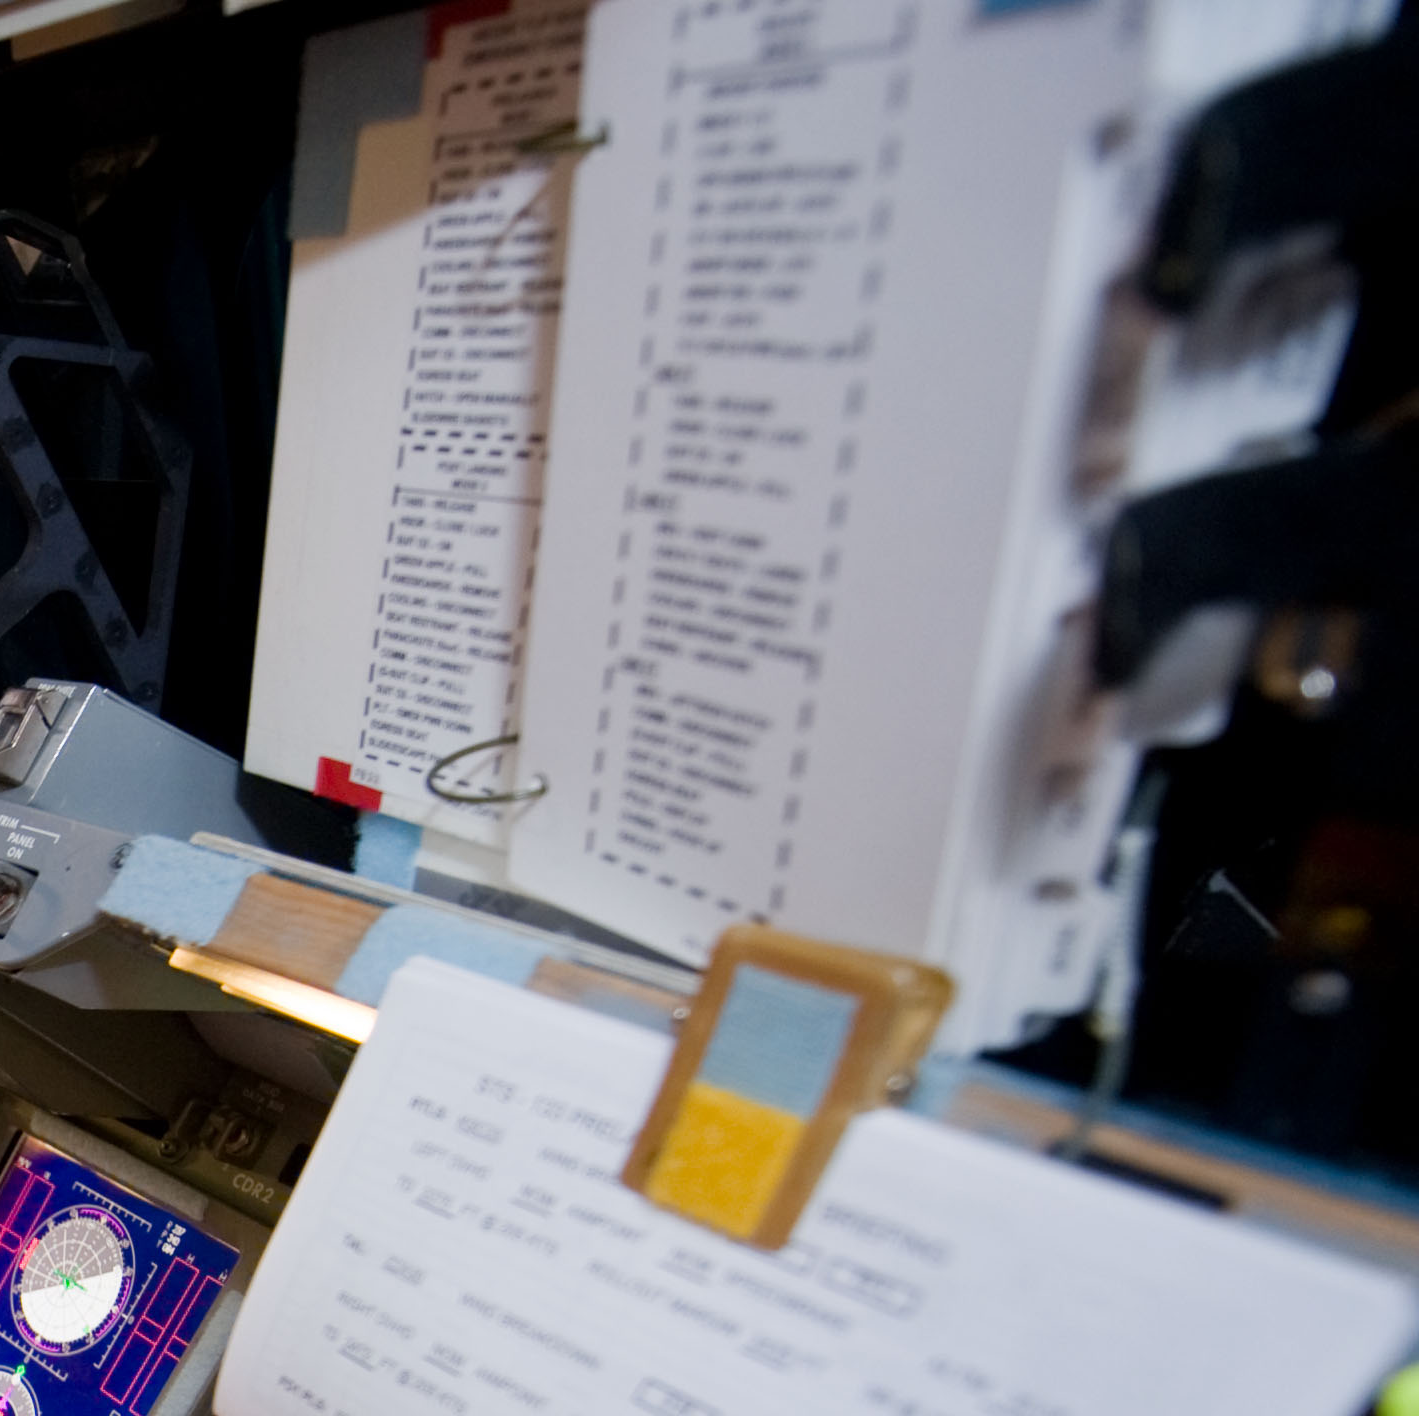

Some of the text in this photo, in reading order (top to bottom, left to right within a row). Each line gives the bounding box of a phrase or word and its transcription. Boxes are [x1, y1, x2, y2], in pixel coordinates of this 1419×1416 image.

[6, 831, 36, 848] PANEL
[6, 846, 23, 860] ON
[229, 1172, 277, 1204] CDR2
